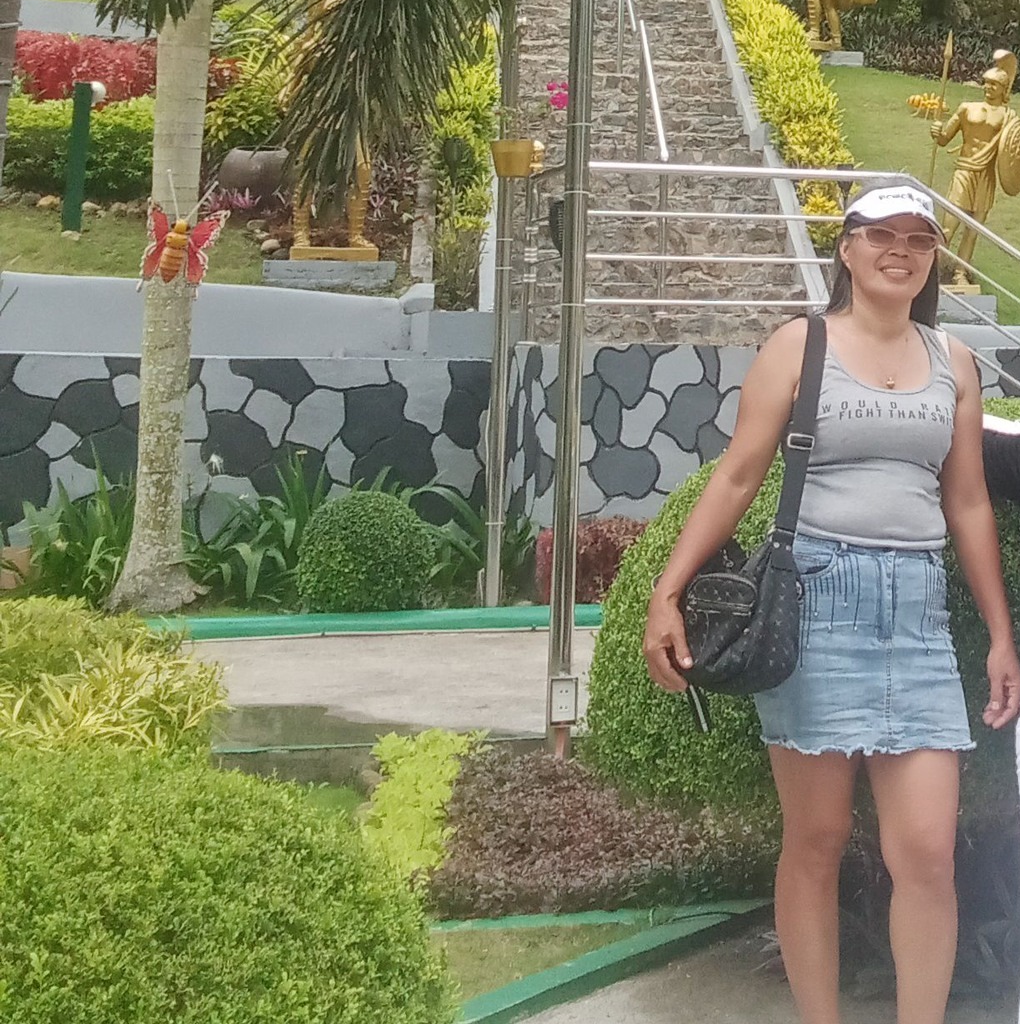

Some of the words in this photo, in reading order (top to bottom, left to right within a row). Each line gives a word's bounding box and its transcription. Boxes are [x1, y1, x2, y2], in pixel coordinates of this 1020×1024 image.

[822, 400, 897, 414] WOULD
[839, 408, 882, 420] FIGHT
[888, 409, 926, 420] THAN
